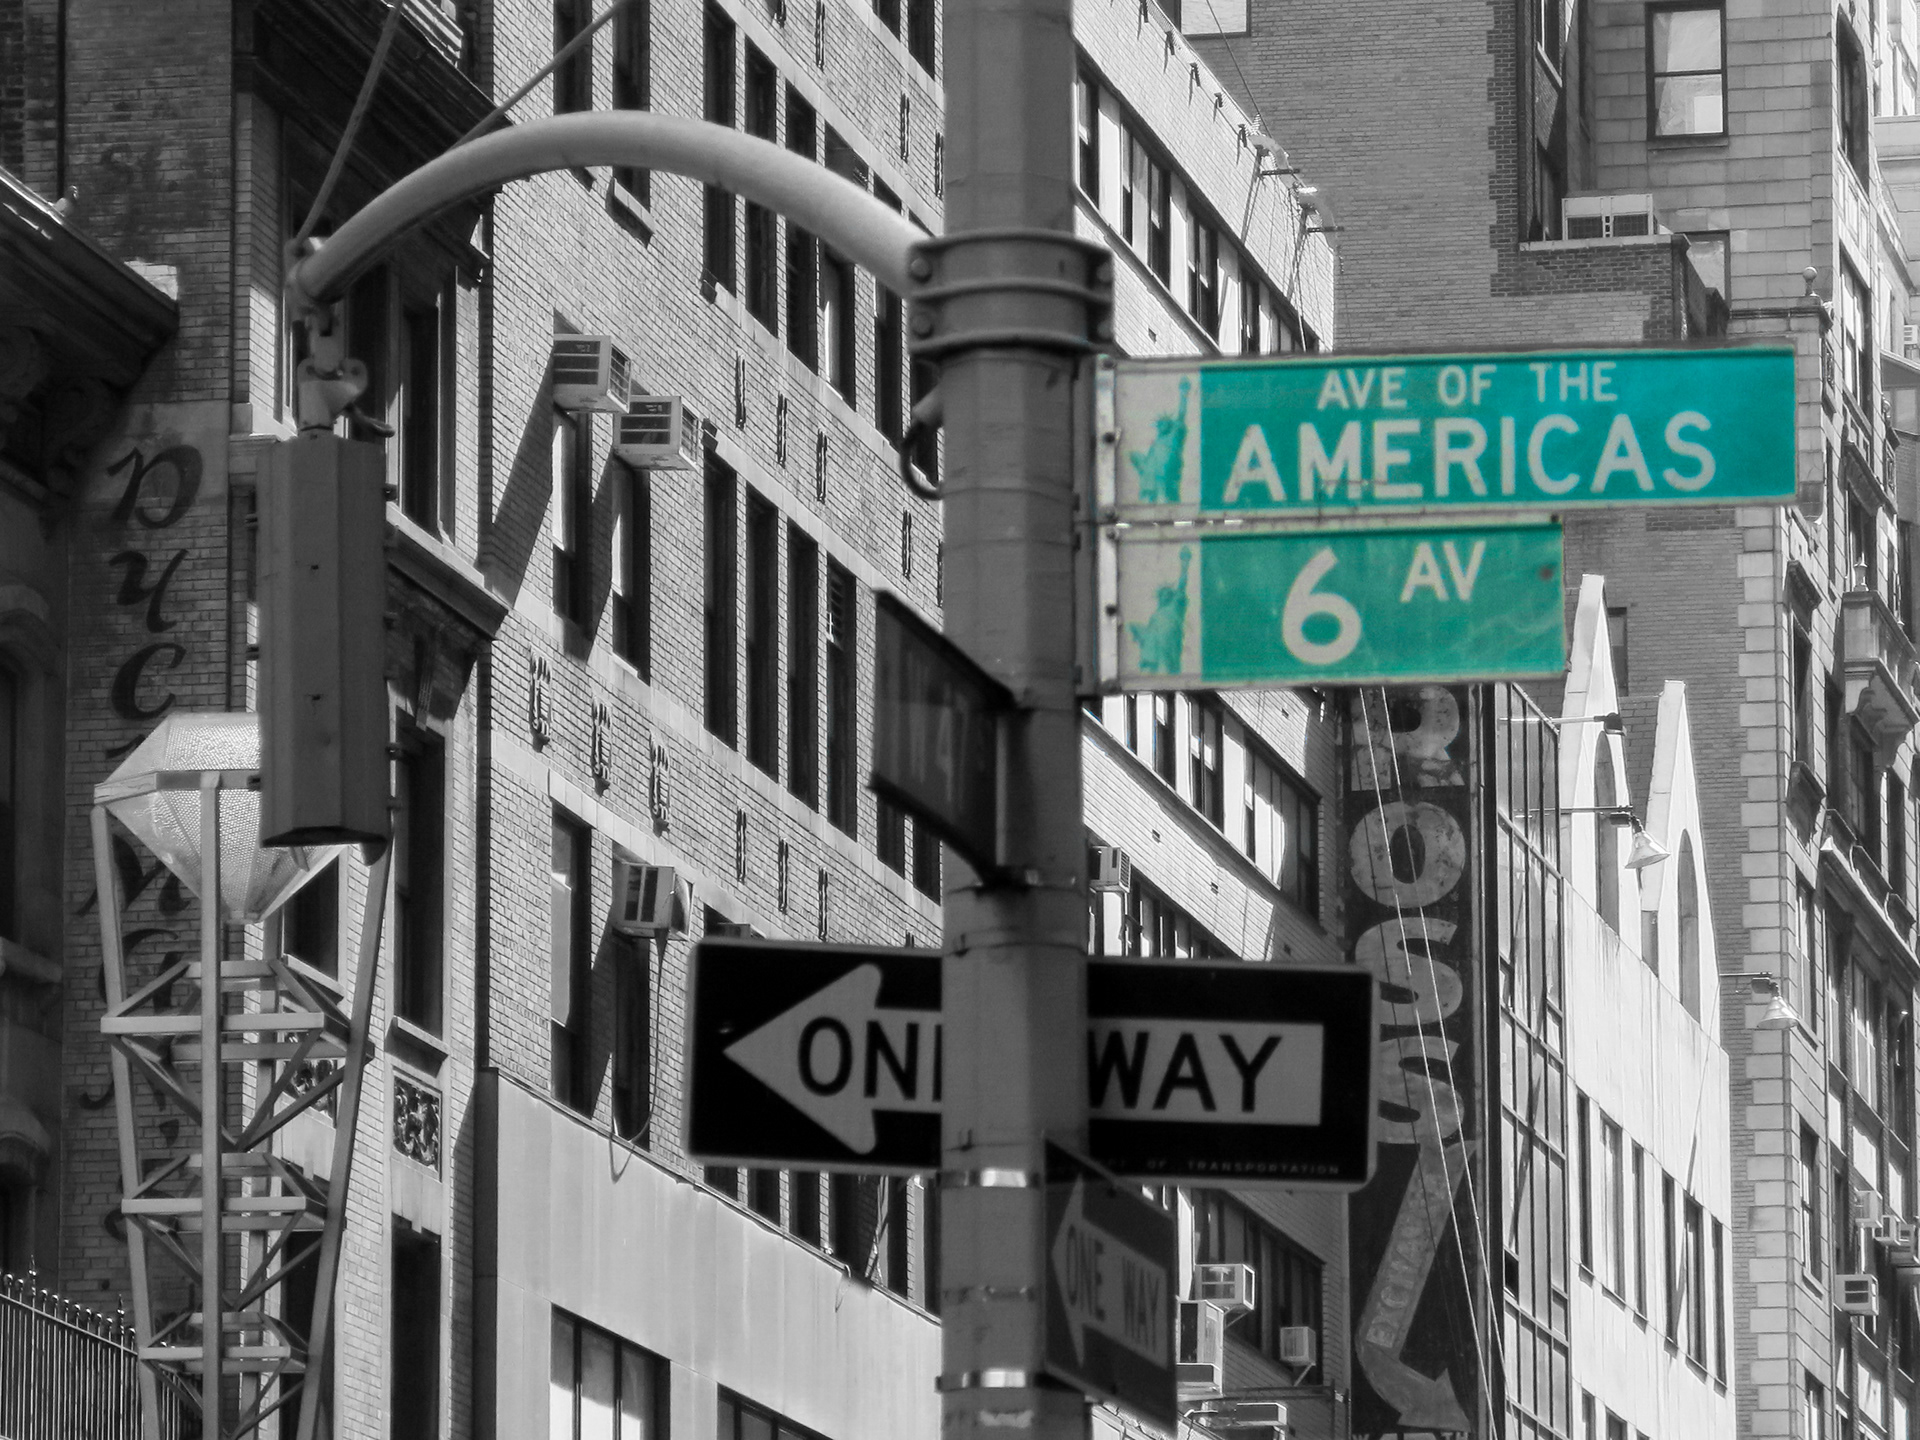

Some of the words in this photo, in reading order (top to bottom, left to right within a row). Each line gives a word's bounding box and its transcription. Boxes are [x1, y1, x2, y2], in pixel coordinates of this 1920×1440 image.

[1318, 366, 1407, 410] AVE
[1438, 364, 1497, 405] OF
[1529, 361, 1619, 403] THE
[1223, 412, 1717, 503] AMERICAS
[1281, 546, 1362, 665] 6
[1401, 541, 1486, 602] AV
[798, 1015, 943, 1101] ON
[1088, 1030, 1283, 1113] WAY
[1187, 1158, 1340, 1175] TRANSPORTATION
[1065, 1223, 1106, 1321] ONE
[1121, 1255, 1160, 1354] WAY
